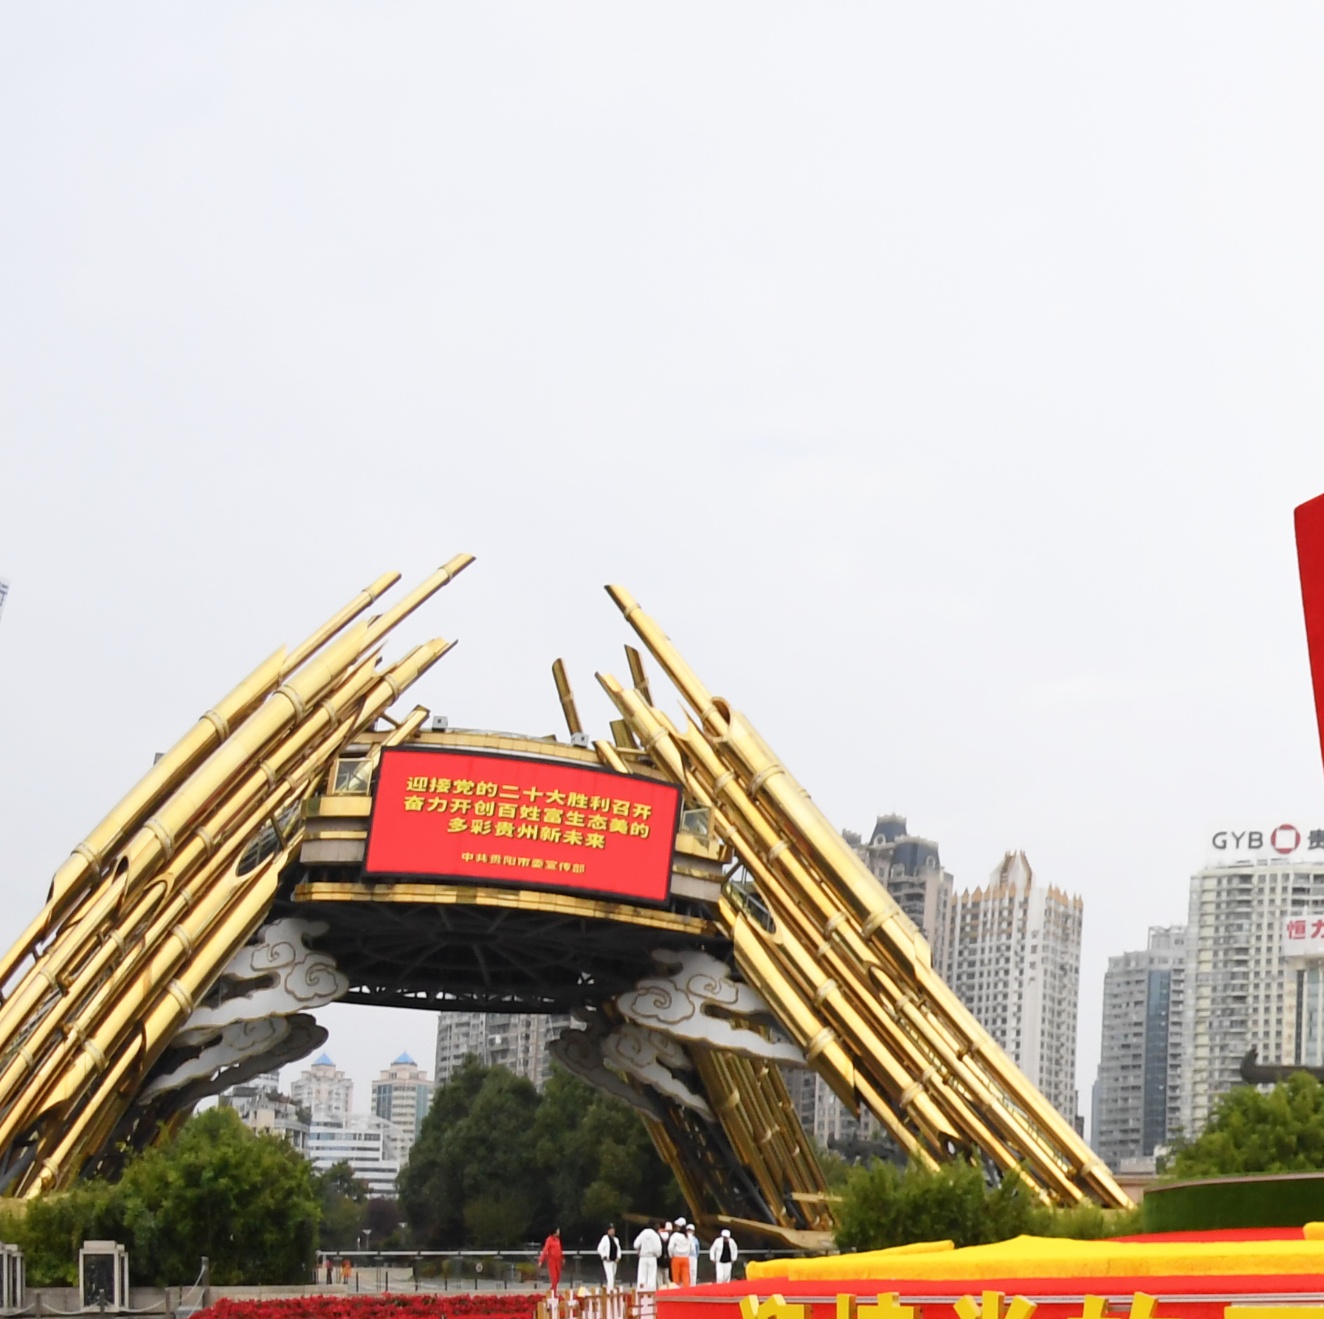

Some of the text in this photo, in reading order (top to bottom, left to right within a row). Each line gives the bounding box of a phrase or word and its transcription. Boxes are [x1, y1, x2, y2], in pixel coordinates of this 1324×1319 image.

[404, 795, 650, 839] 奋力开创百姓富生态美的
[406, 776, 652, 820] 迎接党的二十大胜利召开
[447, 817, 606, 849] 多彩贵州新未来
[1212, 831, 1264, 850] GYB
